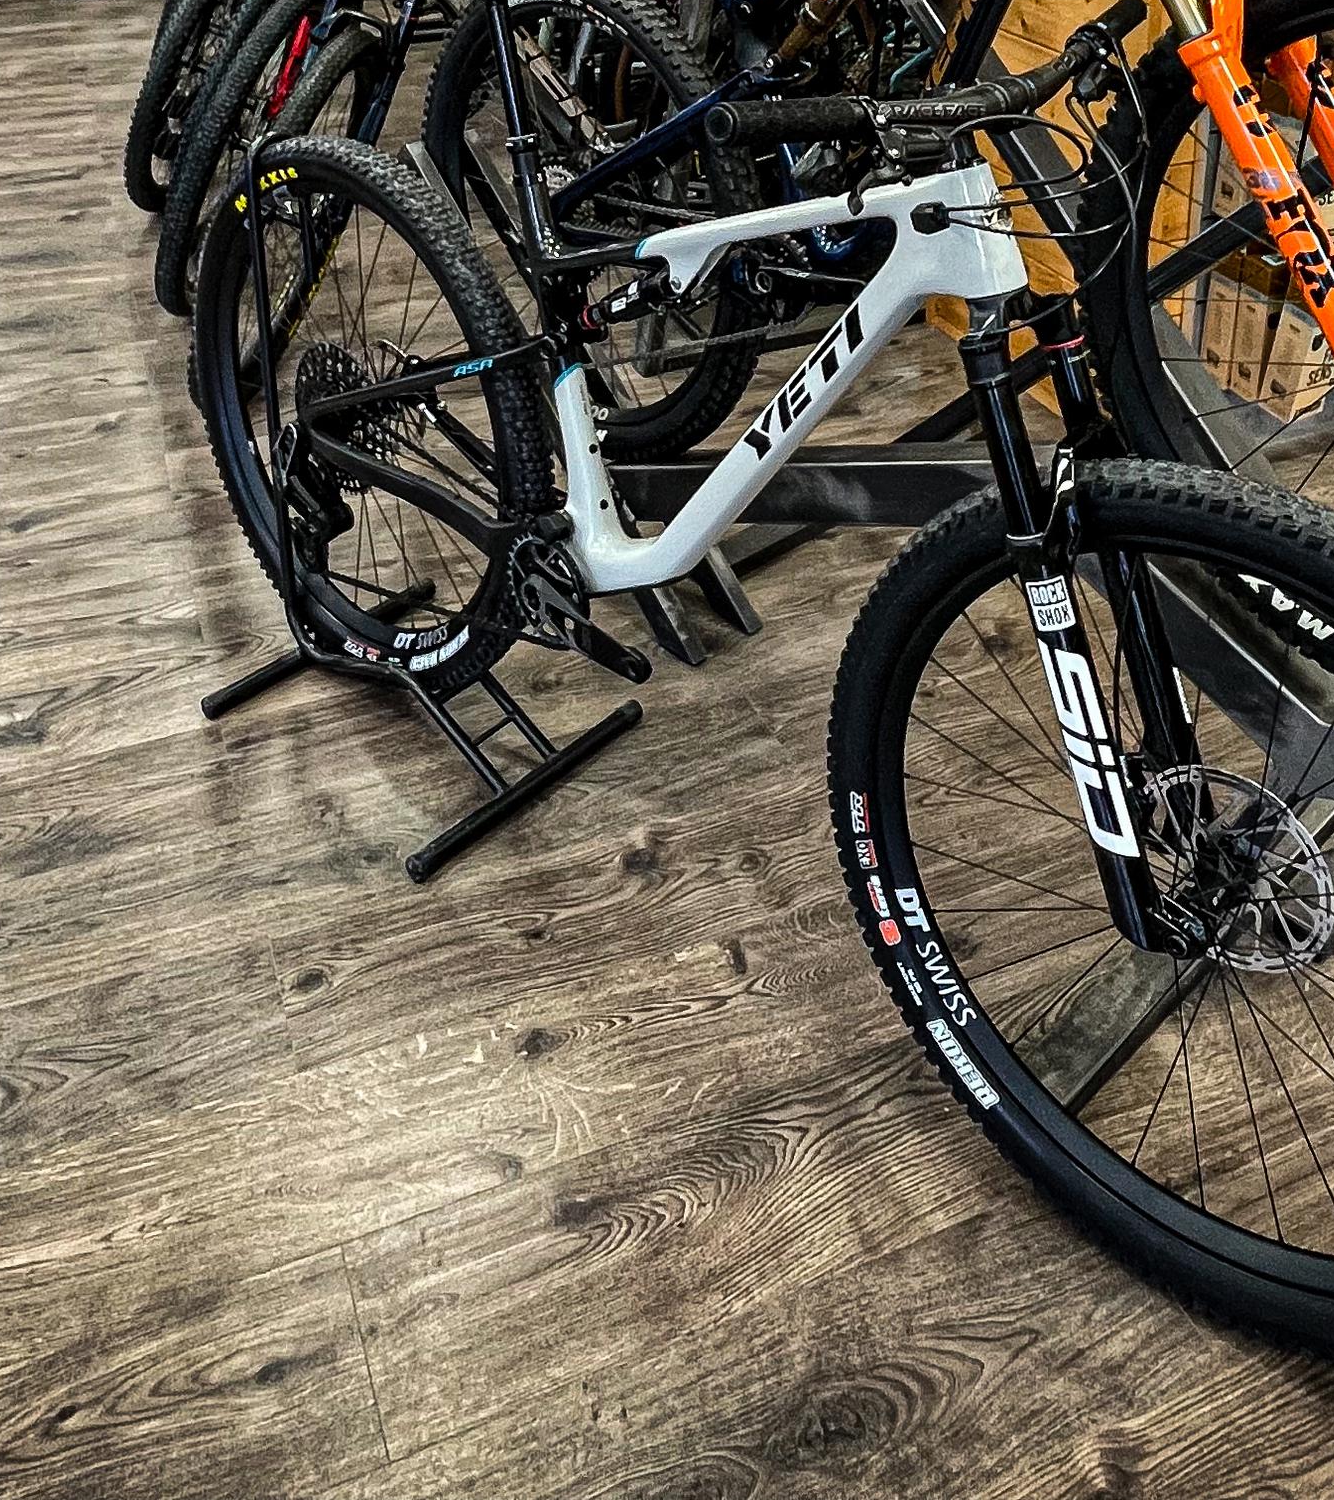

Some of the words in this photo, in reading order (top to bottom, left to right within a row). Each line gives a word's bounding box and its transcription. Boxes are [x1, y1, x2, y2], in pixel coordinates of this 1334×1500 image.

[234, 166, 299, 213] MXXIS
[451, 358, 494, 378] ASR
[743, 302, 865, 461] YETI
[1307, 366, 1332, 386] SENS
[1030, 580, 1066, 605] ROCK
[1037, 605, 1072, 627] SHOX
[393, 632, 416, 650] DT
[1037, 637, 1140, 858] SID
[895, 887, 932, 933] DT
[916, 940, 977, 1027] SWISS
[926, 1019, 1000, 1110] REKON
